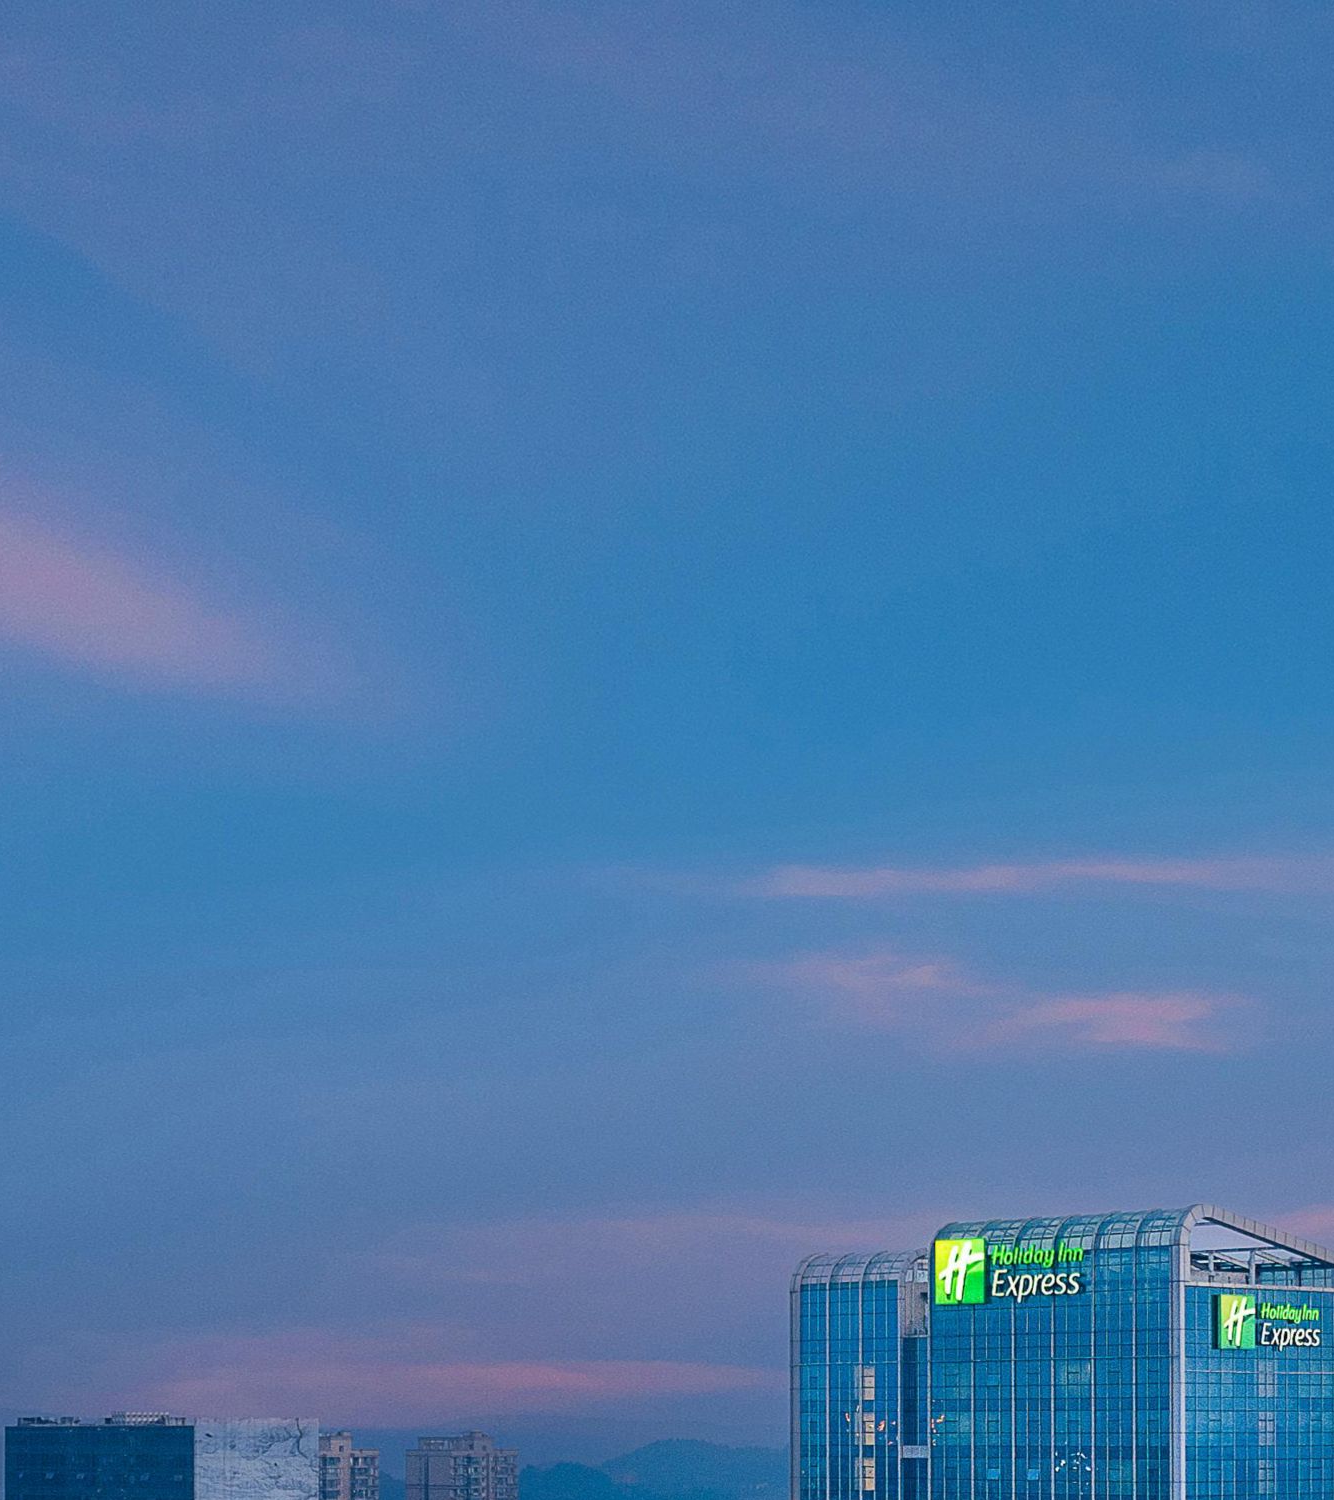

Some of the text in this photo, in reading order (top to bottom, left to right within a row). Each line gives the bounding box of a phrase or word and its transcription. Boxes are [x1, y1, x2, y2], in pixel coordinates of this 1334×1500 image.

[992, 1241, 1084, 1268] Holiday Inn
[991, 1269, 1081, 1304] Express
[1260, 1302, 1320, 1324] Holiday Inn
[1260, 1322, 1321, 1351] Express
